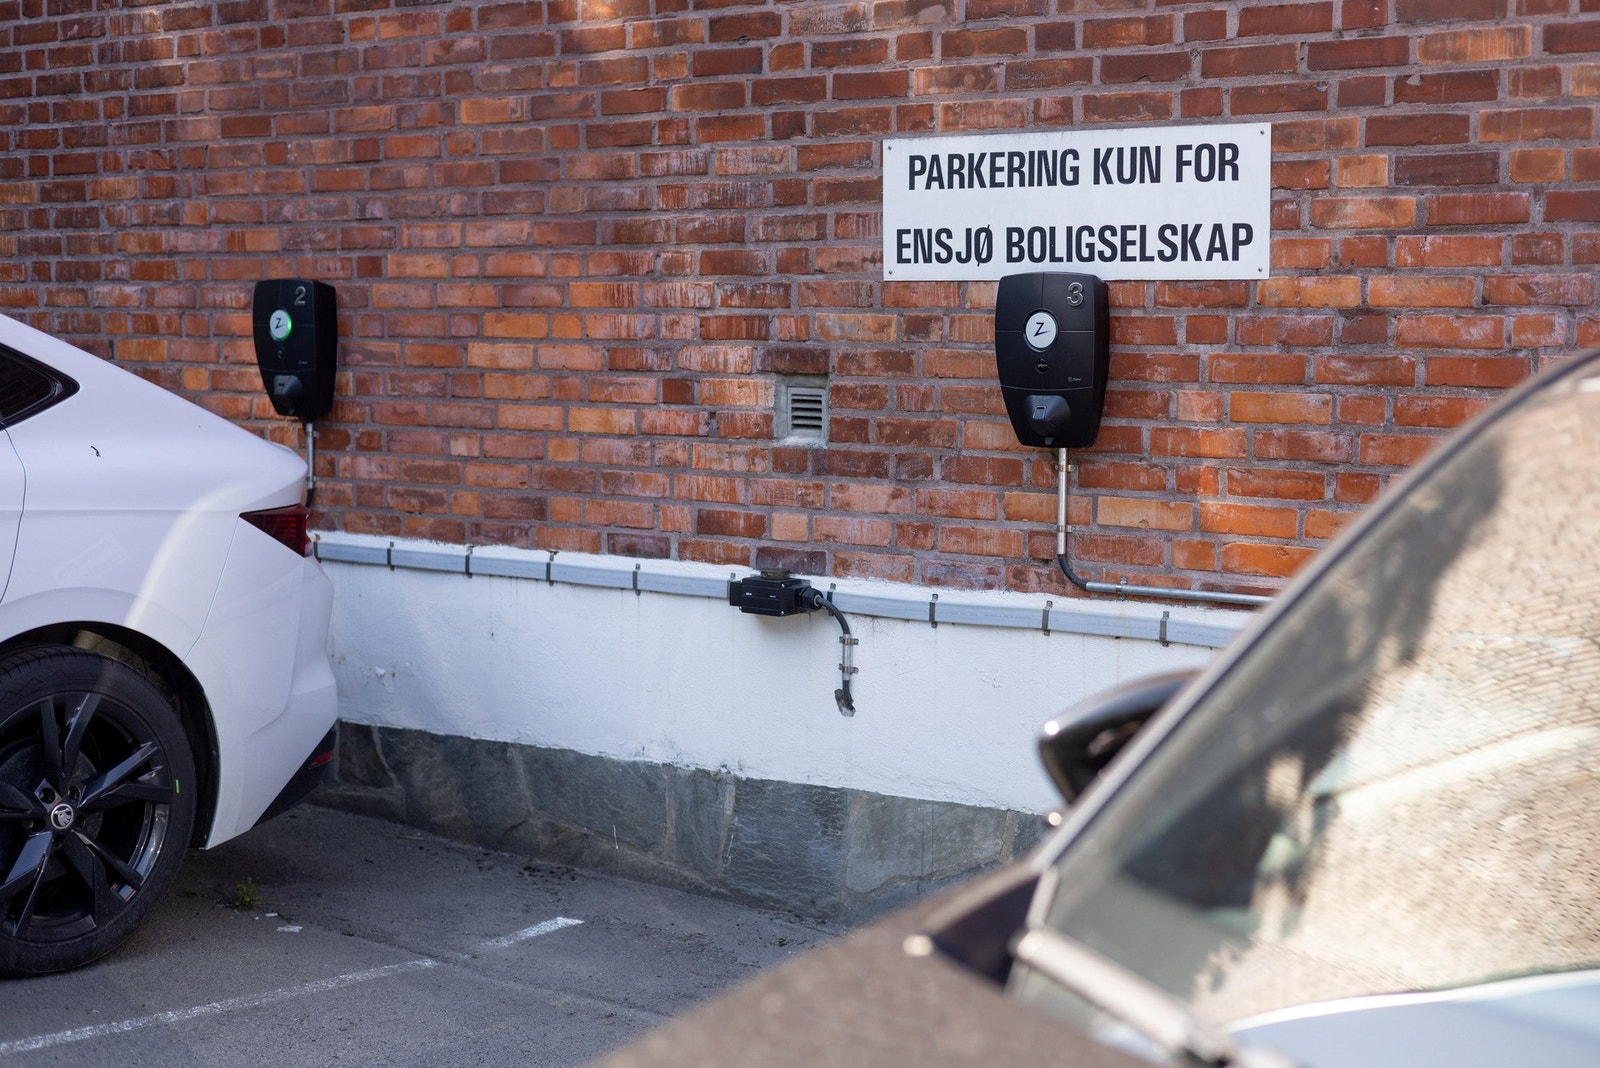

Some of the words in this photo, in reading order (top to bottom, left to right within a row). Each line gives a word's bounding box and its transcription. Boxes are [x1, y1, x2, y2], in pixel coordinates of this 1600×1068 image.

[909, 149, 1080, 191] PARKERING
[1093, 145, 1161, 186] KUN
[1175, 142, 1240, 183] FOR
[896, 224, 993, 267] ENSJØ
[1006, 222, 1254, 264] BOLIGSELSKAP
[294, 285, 306, 306] 2
[1066, 281, 1084, 307] 3
[275, 317, 285, 329] Z
[1033, 321, 1051, 337] Z
